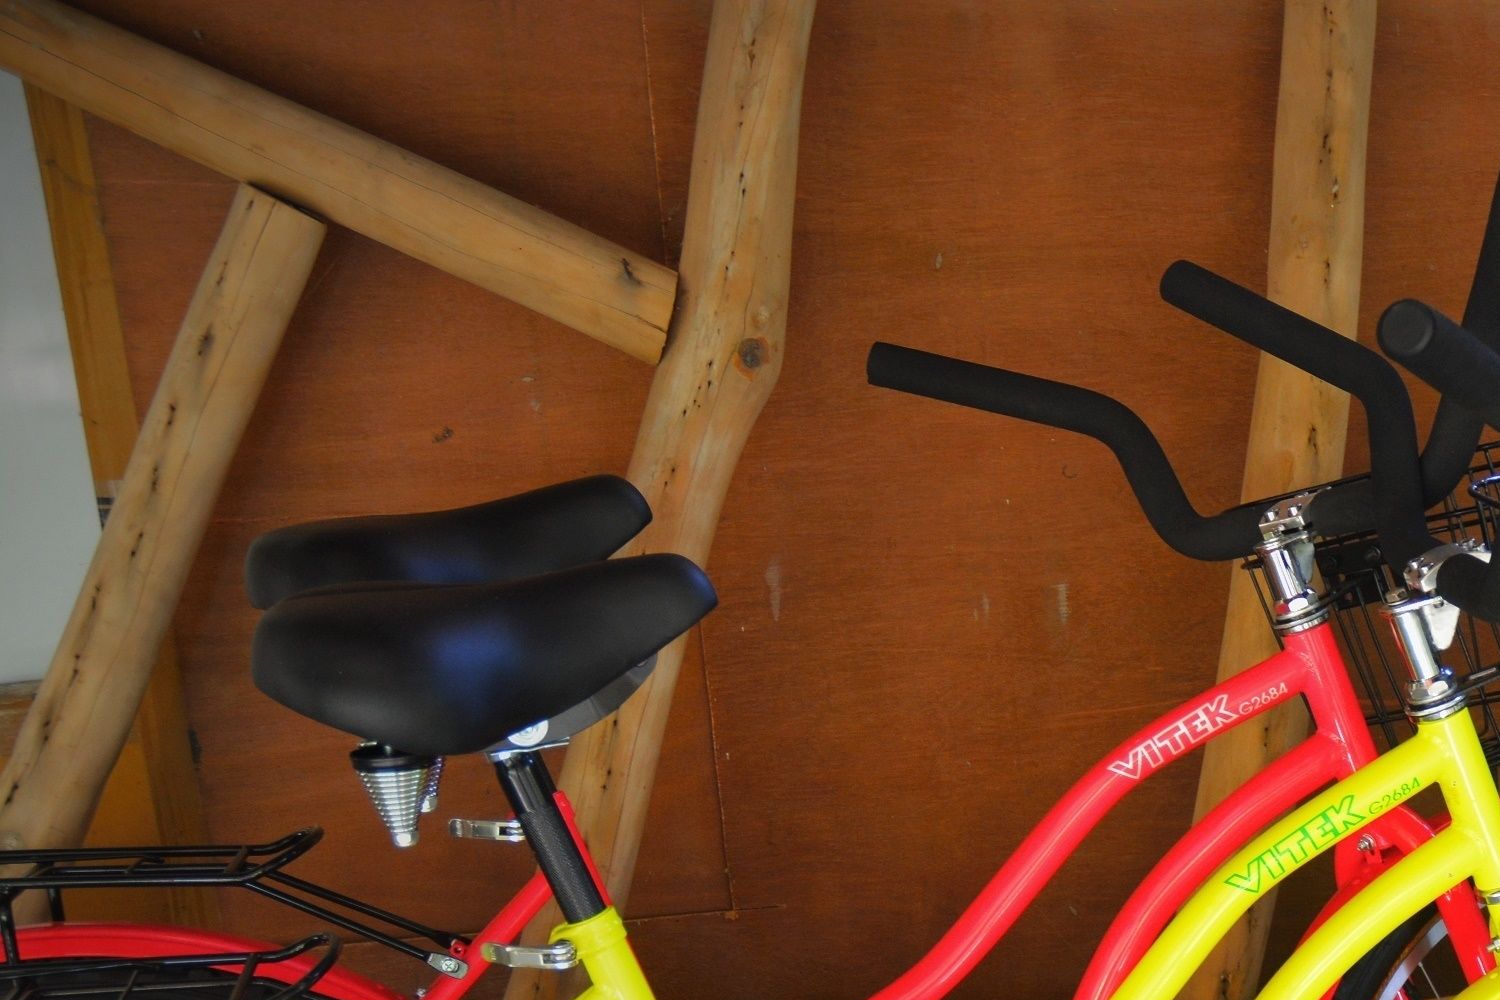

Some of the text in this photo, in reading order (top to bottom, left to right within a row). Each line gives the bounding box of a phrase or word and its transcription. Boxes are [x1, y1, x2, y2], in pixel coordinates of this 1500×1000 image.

[1107, 681, 1289, 780] VITEK G2684
[1223, 776, 1421, 895] VITEK G2684
